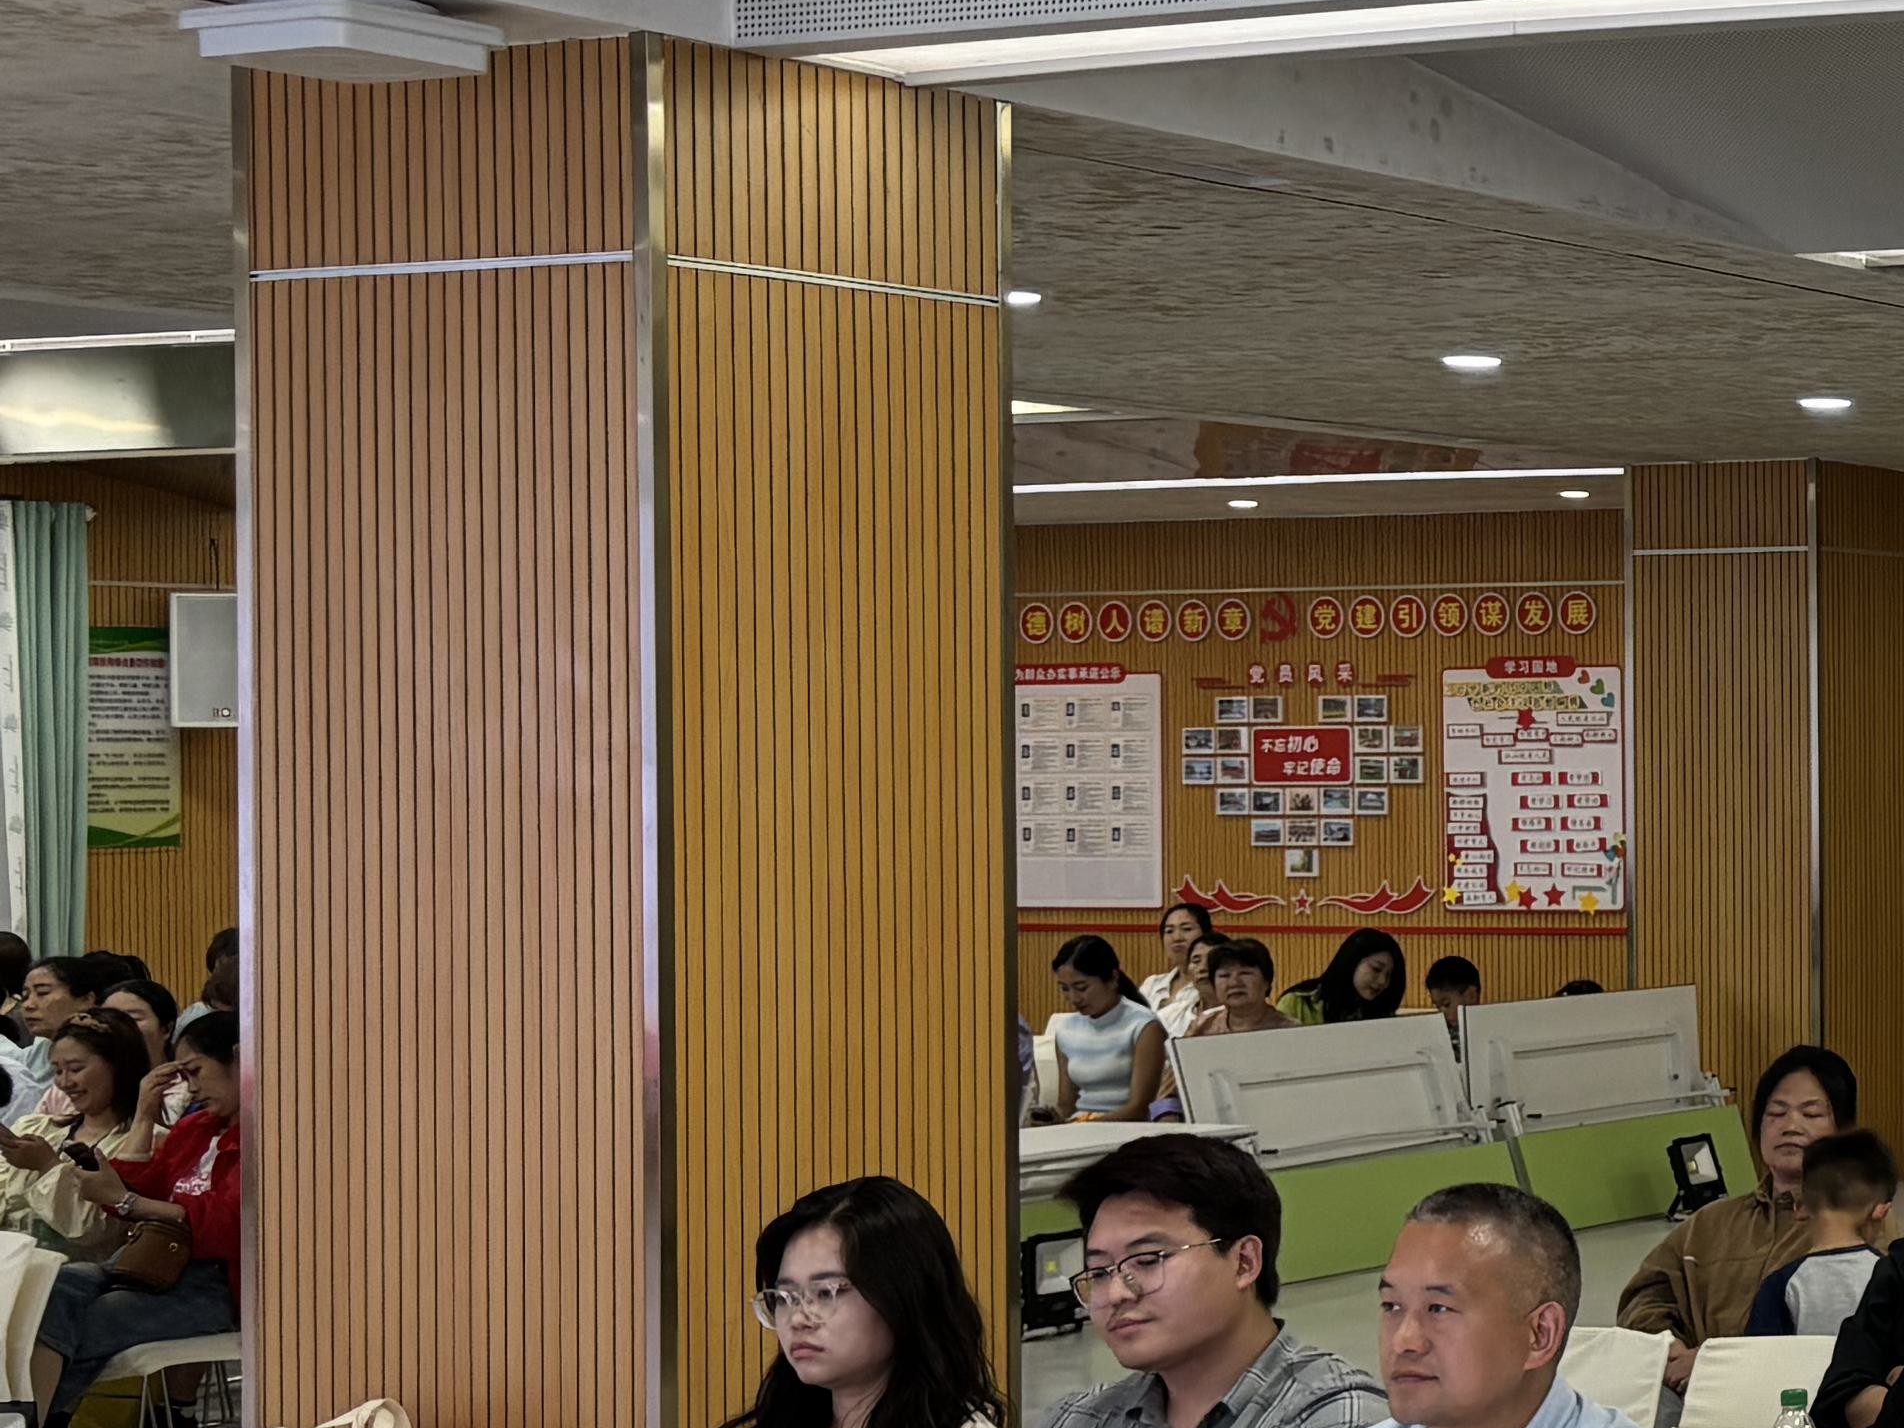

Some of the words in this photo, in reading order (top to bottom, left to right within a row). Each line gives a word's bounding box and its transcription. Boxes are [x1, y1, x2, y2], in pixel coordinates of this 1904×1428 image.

[1313, 599, 1589, 630] 党建引领谋发展
[1249, 663, 1354, 683] 党员风采
[1503, 660, 1558, 674] 学习园地
[1261, 734, 1319, 753] 不忘初心
[1283, 757, 1341, 776] 牢记使命
